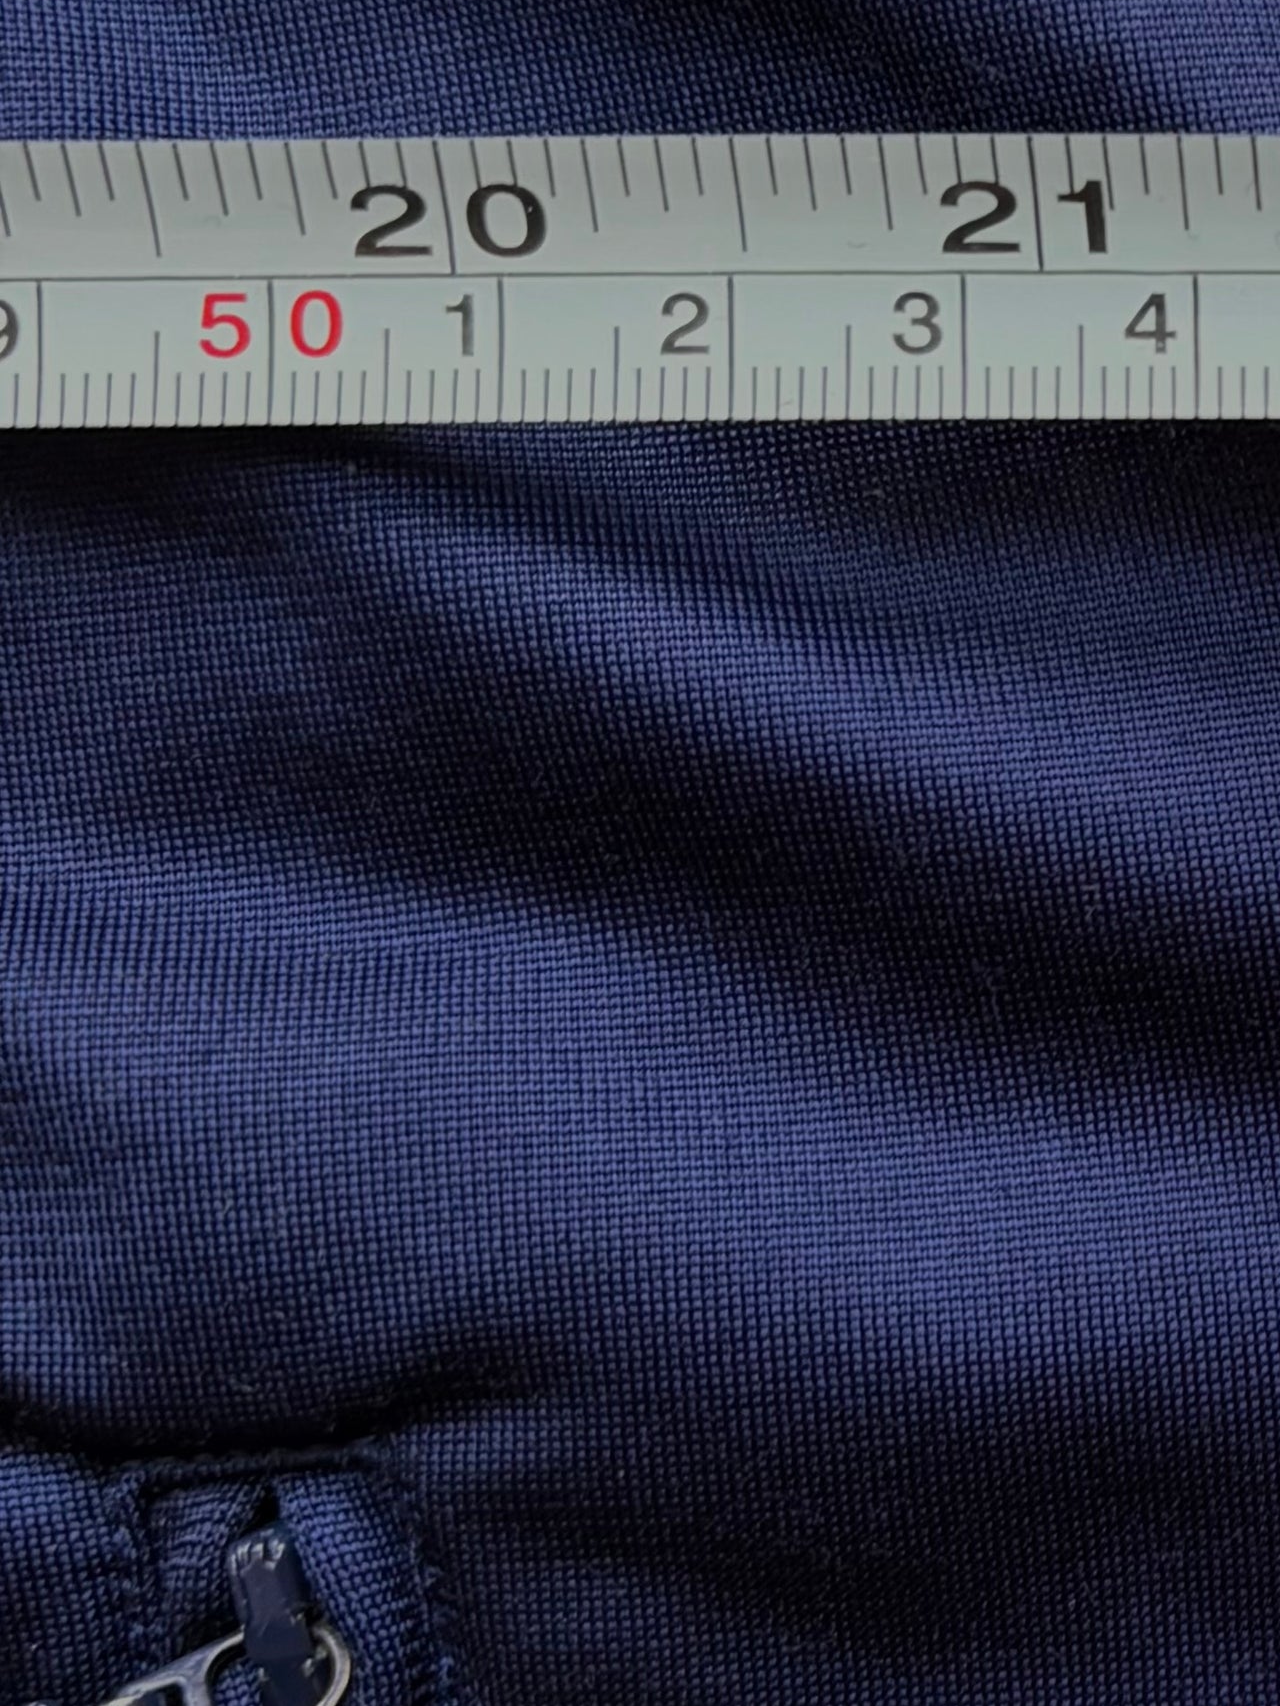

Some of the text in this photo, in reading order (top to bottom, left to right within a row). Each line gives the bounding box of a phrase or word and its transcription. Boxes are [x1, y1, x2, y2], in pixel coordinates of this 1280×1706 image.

[348, 184, 548, 259] 20
[939, 180, 1110, 255] 21
[199, 293, 343, 357] 50
[444, 295, 475, 356] 1
[660, 294, 709, 354] 2
[893, 293, 942, 353] 3
[1124, 293, 1176, 353] 4
